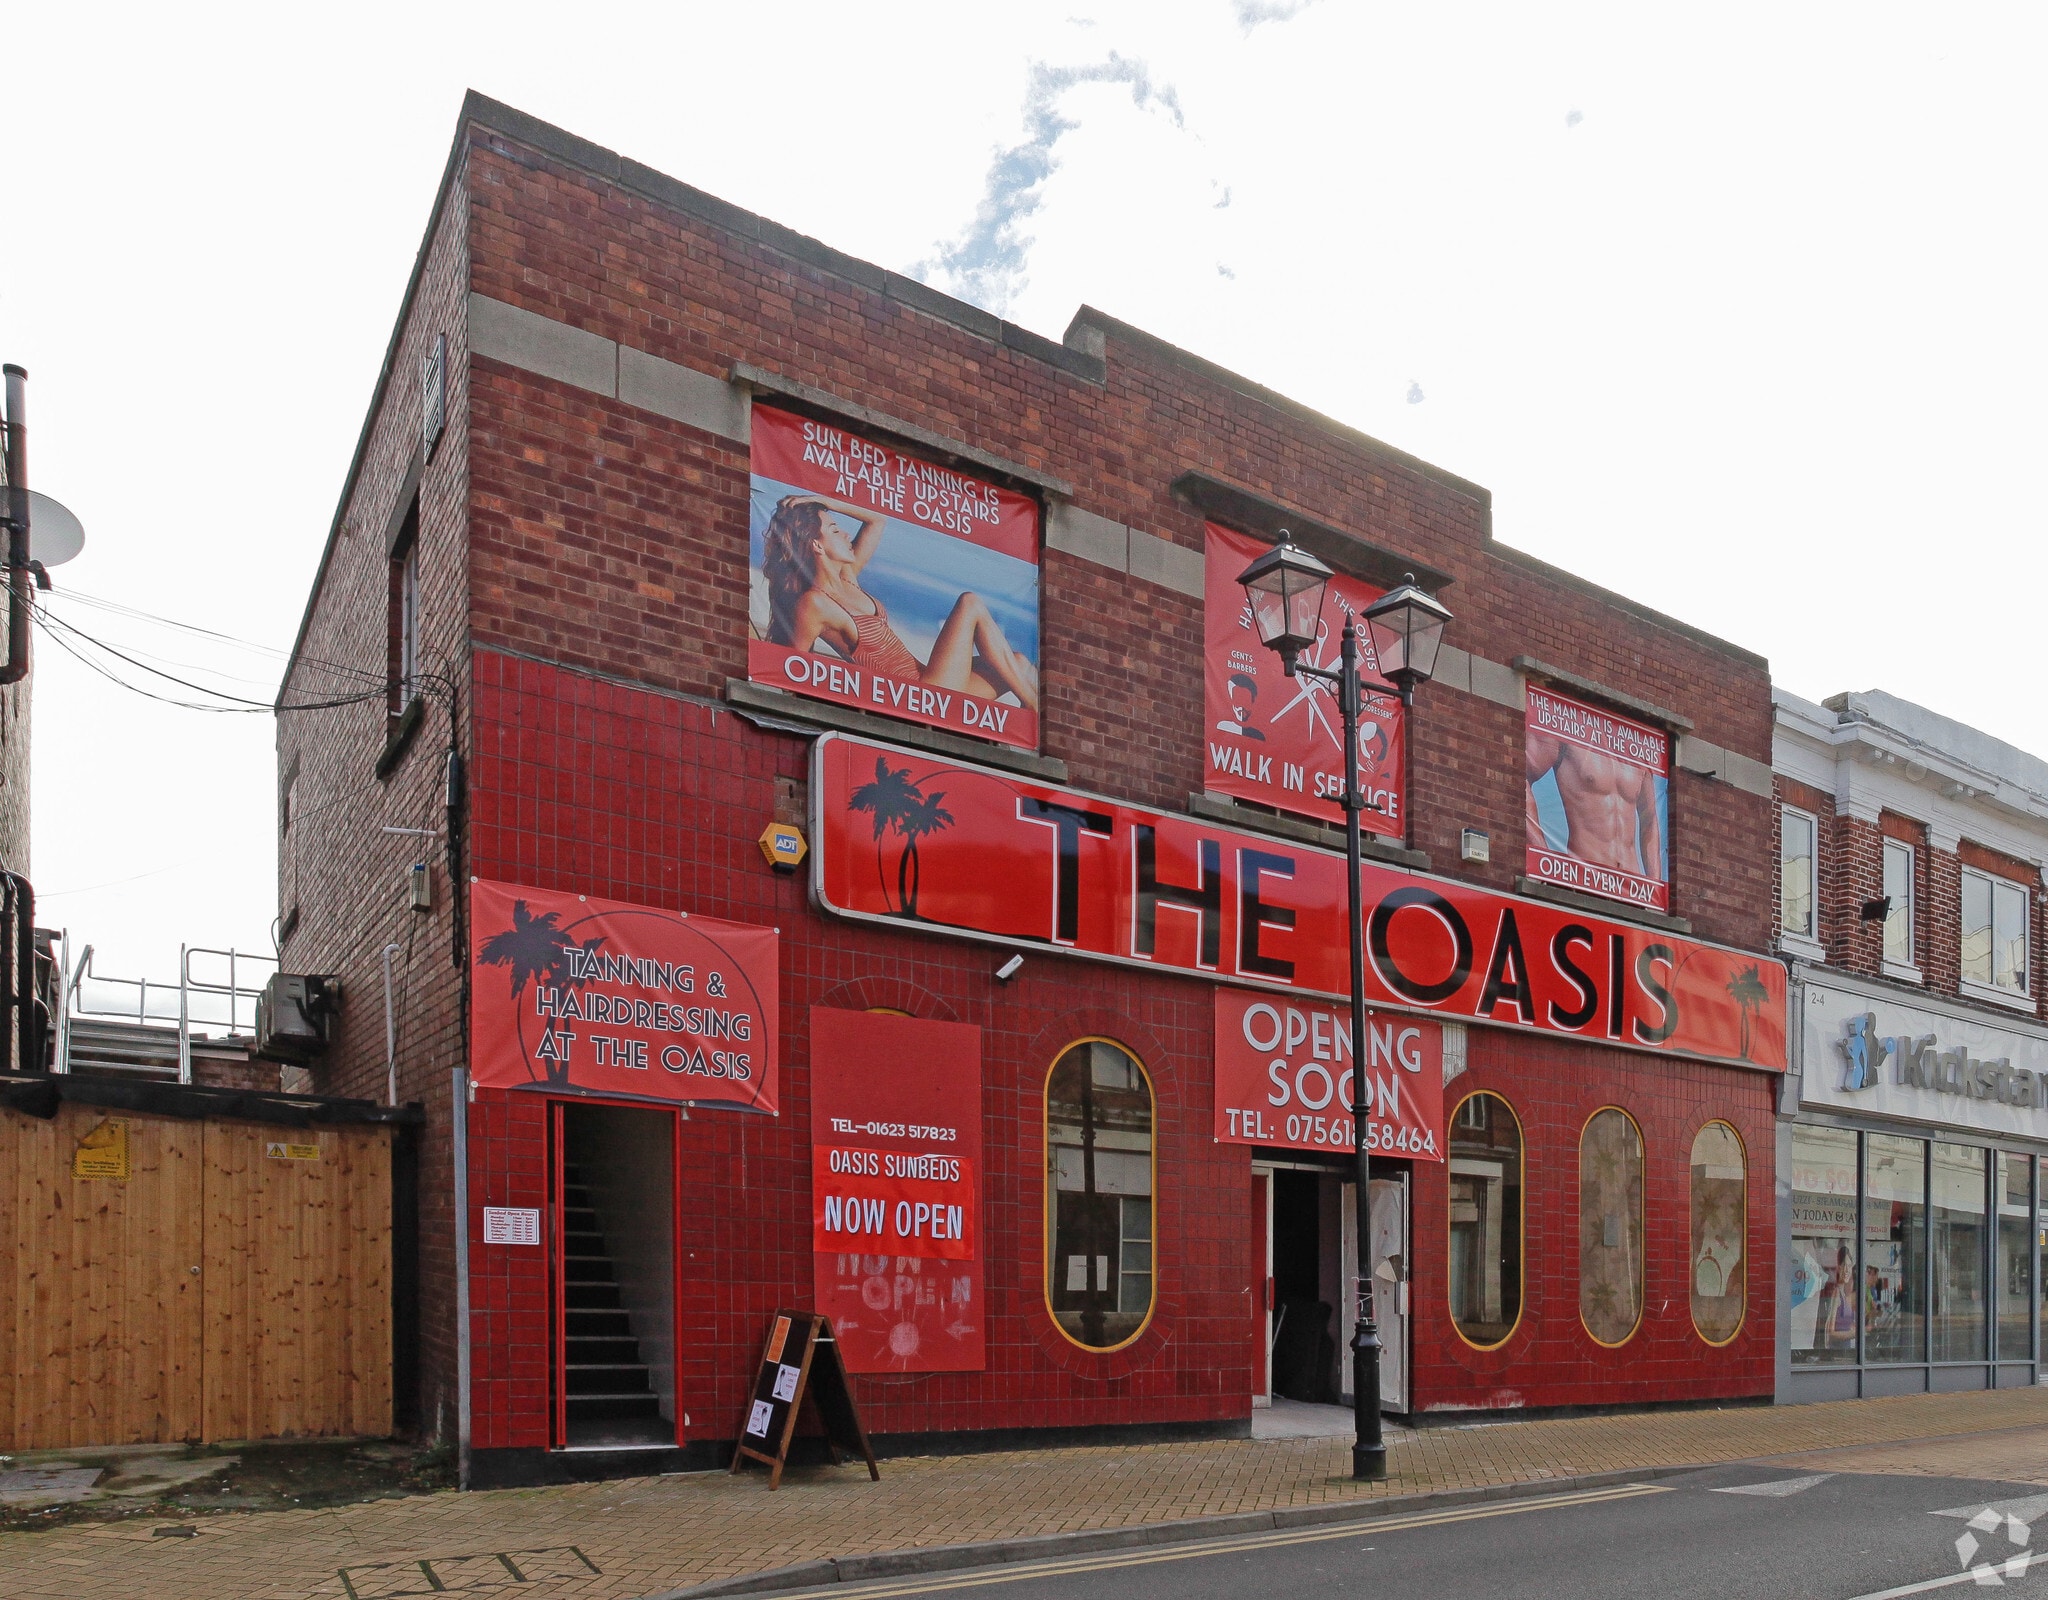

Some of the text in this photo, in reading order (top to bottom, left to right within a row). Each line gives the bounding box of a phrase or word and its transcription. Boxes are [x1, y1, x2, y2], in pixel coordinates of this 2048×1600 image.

[803, 422, 999, 505] SUN BED TANNING IS
[803, 444, 1000, 526] AVAILABLE UPSTAIRS
[835, 476, 972, 535] AT THE OASIS
[1228, 660, 1257, 675] BARBERS
[1231, 650, 1253, 663] GENTS
[1355, 623, 1377, 671] OASIS
[784, 656, 1009, 733] OPEN EVERY DAY
[1529, 691, 1665, 754] THE MAN TAN IS AVAILABLE
[1538, 709, 1659, 765] UPSTAIRS AT THE OASIS
[1209, 742, 1398, 819] WALK IN SEICE
[776, 838, 797, 850] ADT
[1539, 856, 1655, 903] OPEN EVERY DAY
[1016, 796, 1680, 1047] THE OASIS
[563, 947, 727, 998] TANNING &
[536, 986, 751, 1041] HAIRDRESSING
[1811, 992, 1825, 1006] 2-4
[535, 1027, 751, 1081] AT THE OASIS
[1242, 1002, 1421, 1073] OPENNG
[908, 1124, 956, 1142] 517823
[1225, 1108, 1435, 1154] TEL: 0756158464
[829, 1150, 960, 1183] OASIS SUNBEDS
[824, 1195, 963, 1241] NOW OPEN
[1803, 1209, 1834, 1221] TODAY
